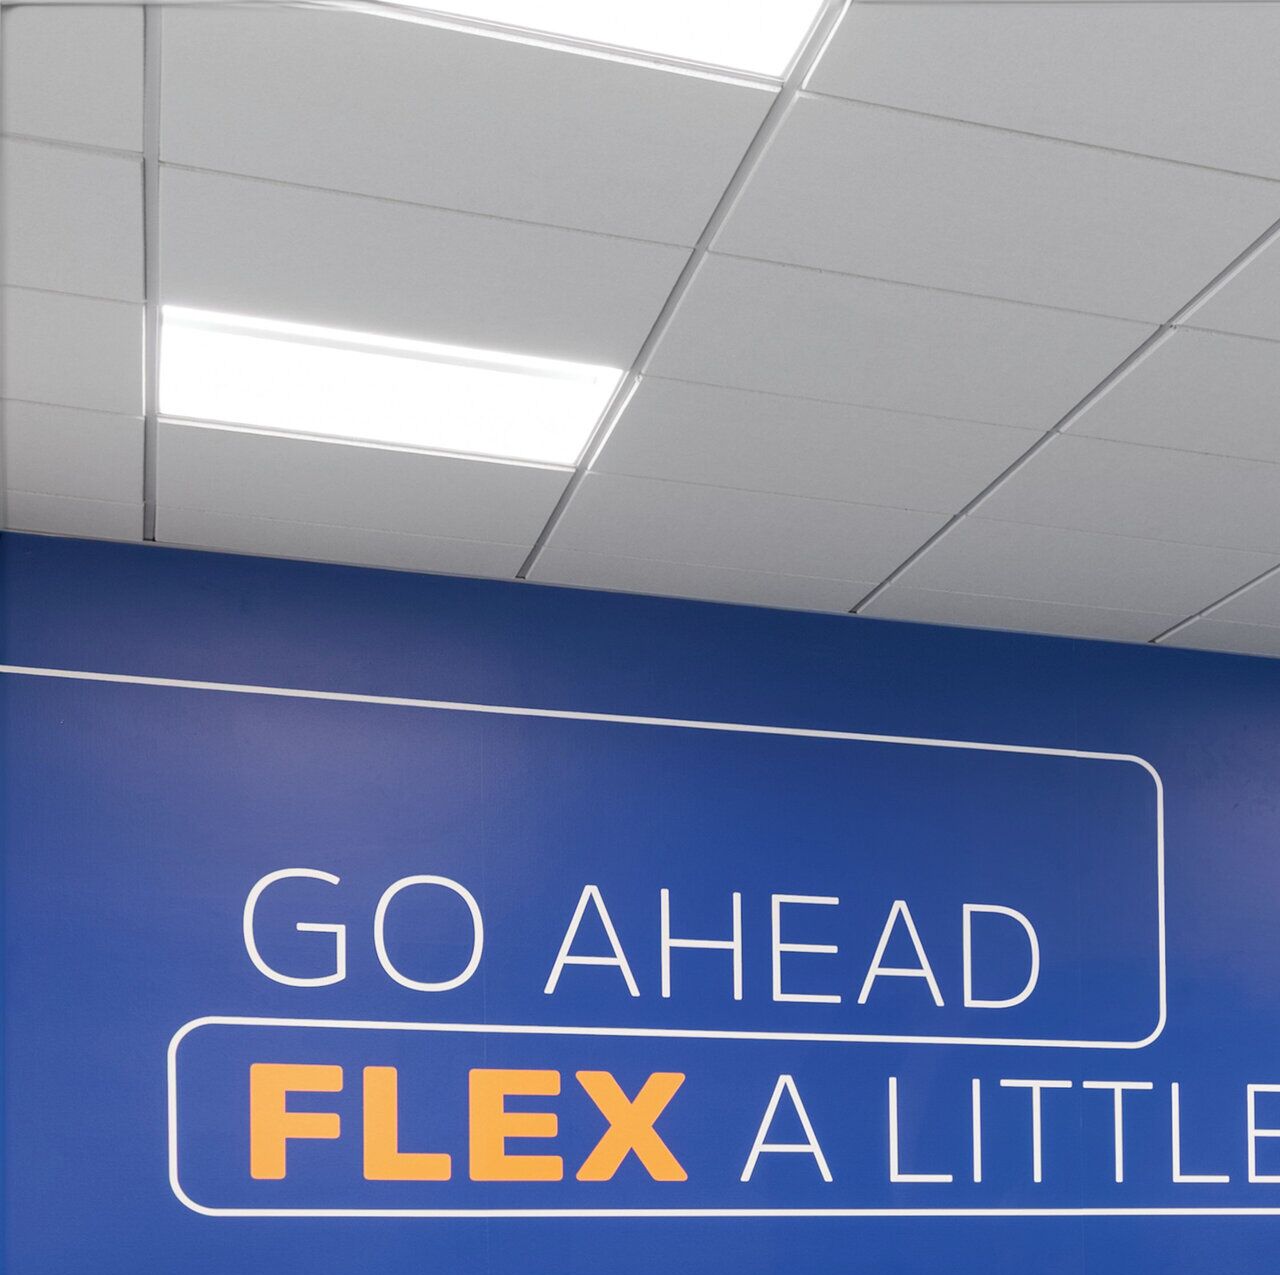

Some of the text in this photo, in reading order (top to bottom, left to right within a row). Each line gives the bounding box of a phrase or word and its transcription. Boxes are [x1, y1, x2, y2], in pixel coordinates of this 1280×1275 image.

[242, 866, 1040, 1009] GO AHEAD
[249, 1062, 689, 1182] FLEX
[740, 1074, 833, 1183] A
